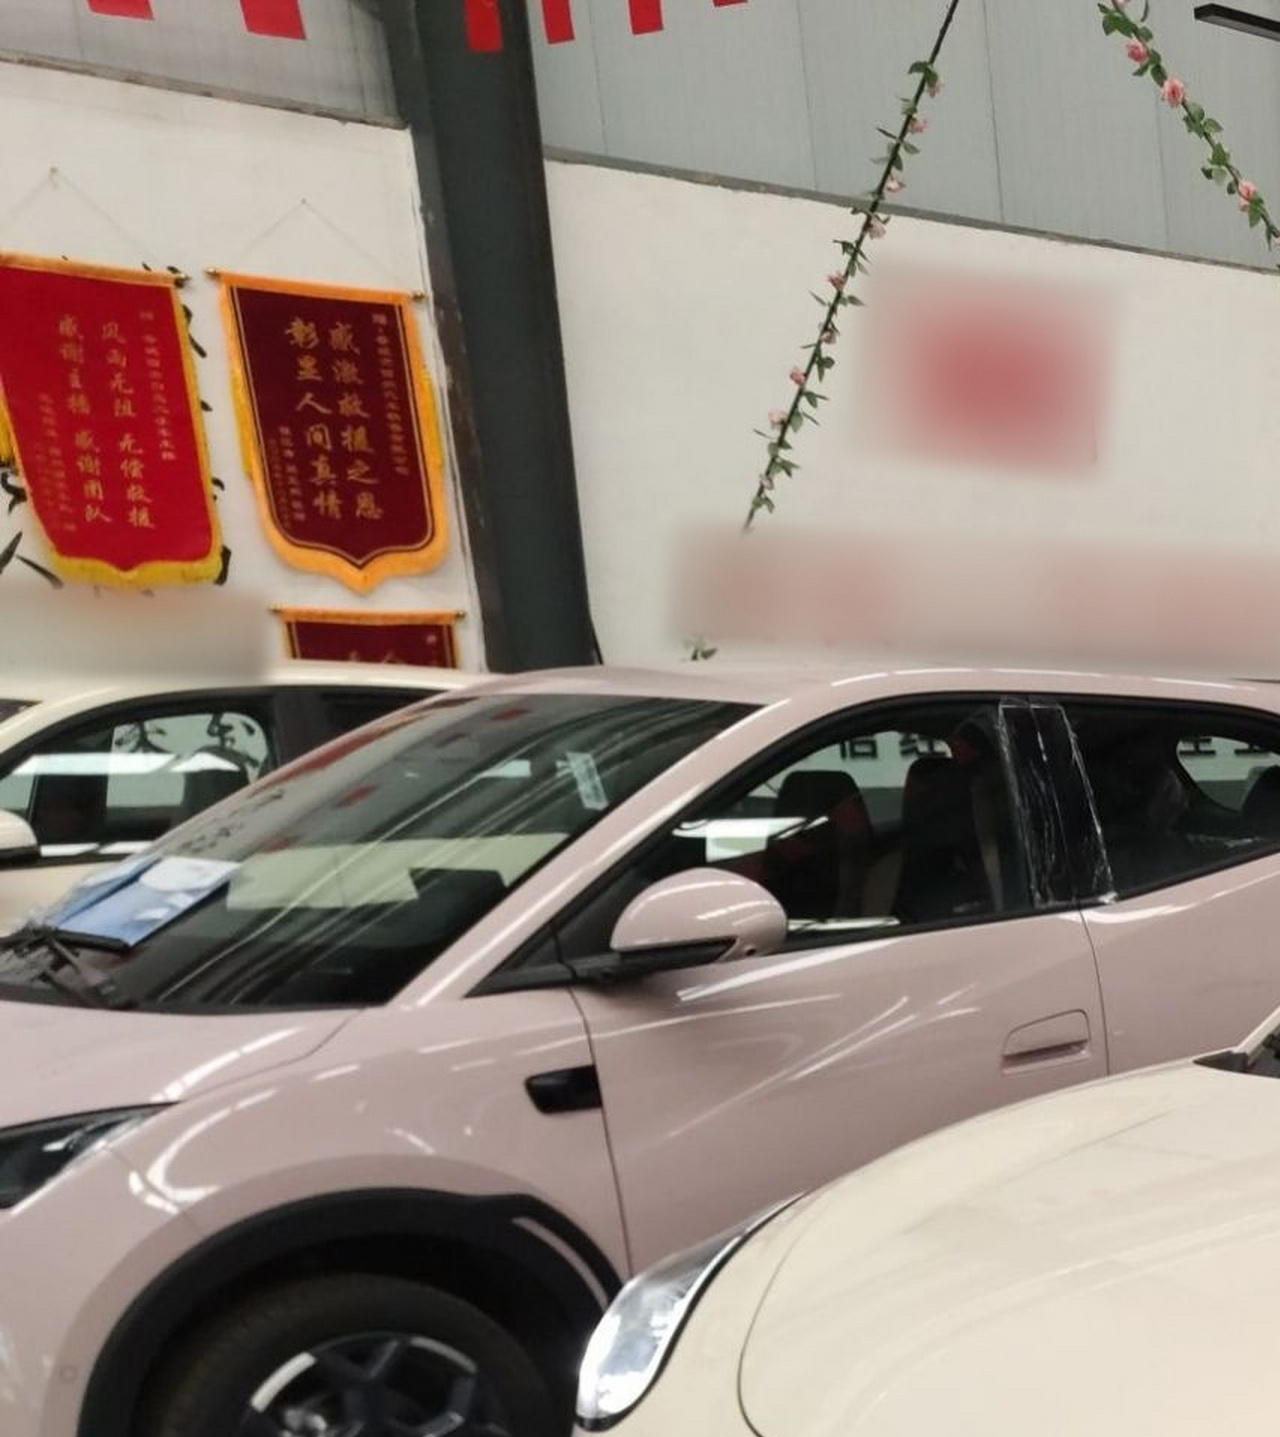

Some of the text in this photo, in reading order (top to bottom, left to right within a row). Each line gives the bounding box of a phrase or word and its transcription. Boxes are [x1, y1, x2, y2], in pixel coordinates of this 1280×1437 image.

[285, 316, 342, 520] 彰显人间真情
[328, 321, 384, 519] 感激救援之恩
